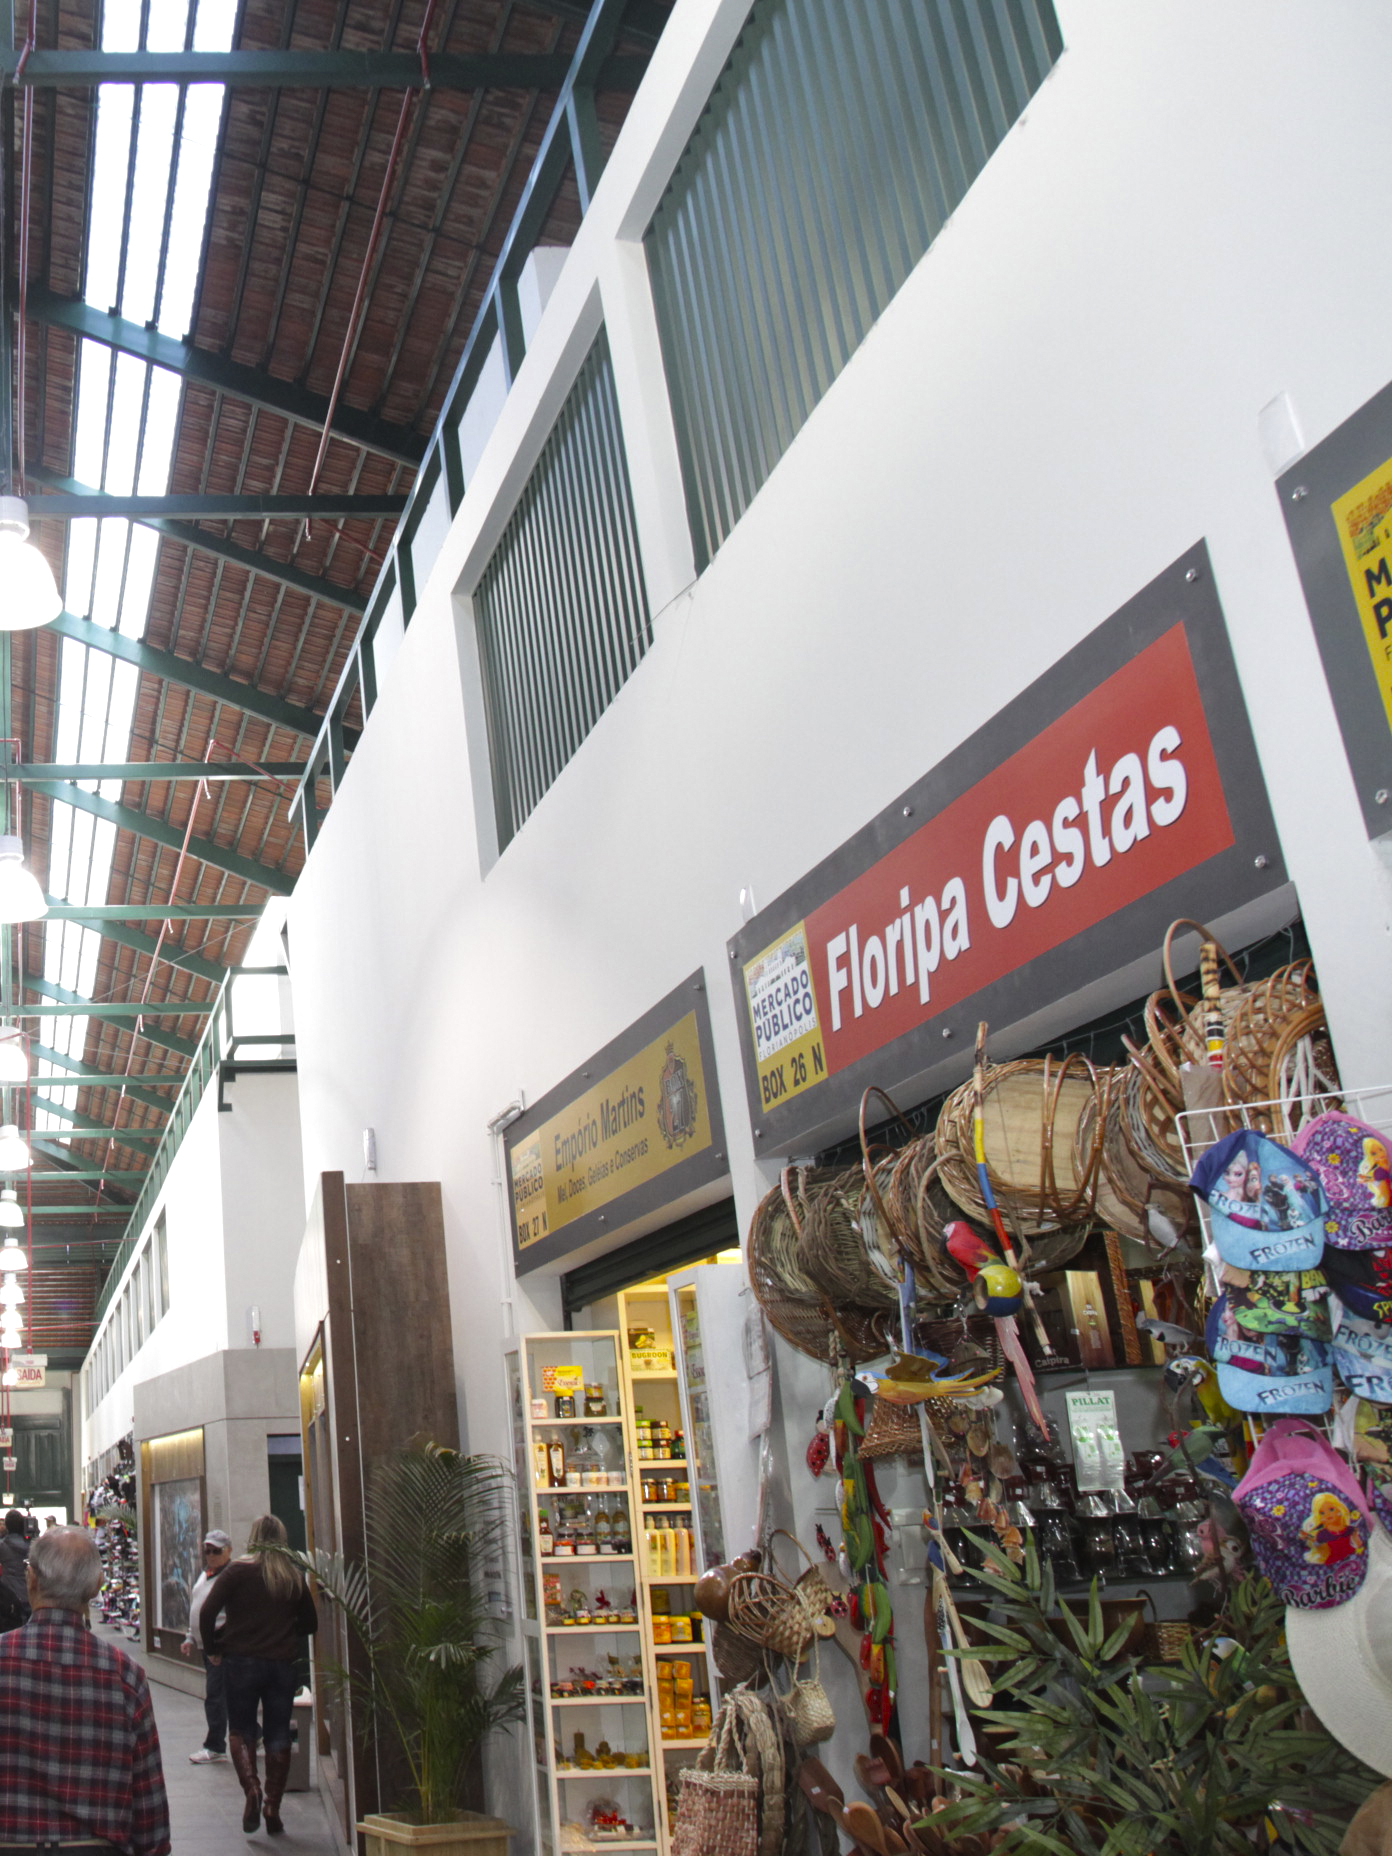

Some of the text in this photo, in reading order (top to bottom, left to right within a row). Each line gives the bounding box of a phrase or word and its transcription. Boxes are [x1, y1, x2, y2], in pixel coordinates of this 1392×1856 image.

[827, 724, 1188, 1033] Floripa Cestas
[752, 969, 809, 1024] MERCADO
[755, 991, 813, 1048] PÚBLICO
[761, 1042, 824, 1105] BOX 26 N
[554, 1085, 645, 1172] Empório Martins
[615, 1138, 649, 1171] Conservas
[513, 1163, 542, 1189] MERCADO
[518, 1210, 548, 1245] BOX 27 N
[1249, 1232, 1317, 1264] FROZEN
[1071, 1396, 1111, 1406] PILLAT
[1255, 1379, 1327, 1406] FROZEN
[1281, 1572, 1357, 1608] Barbie
